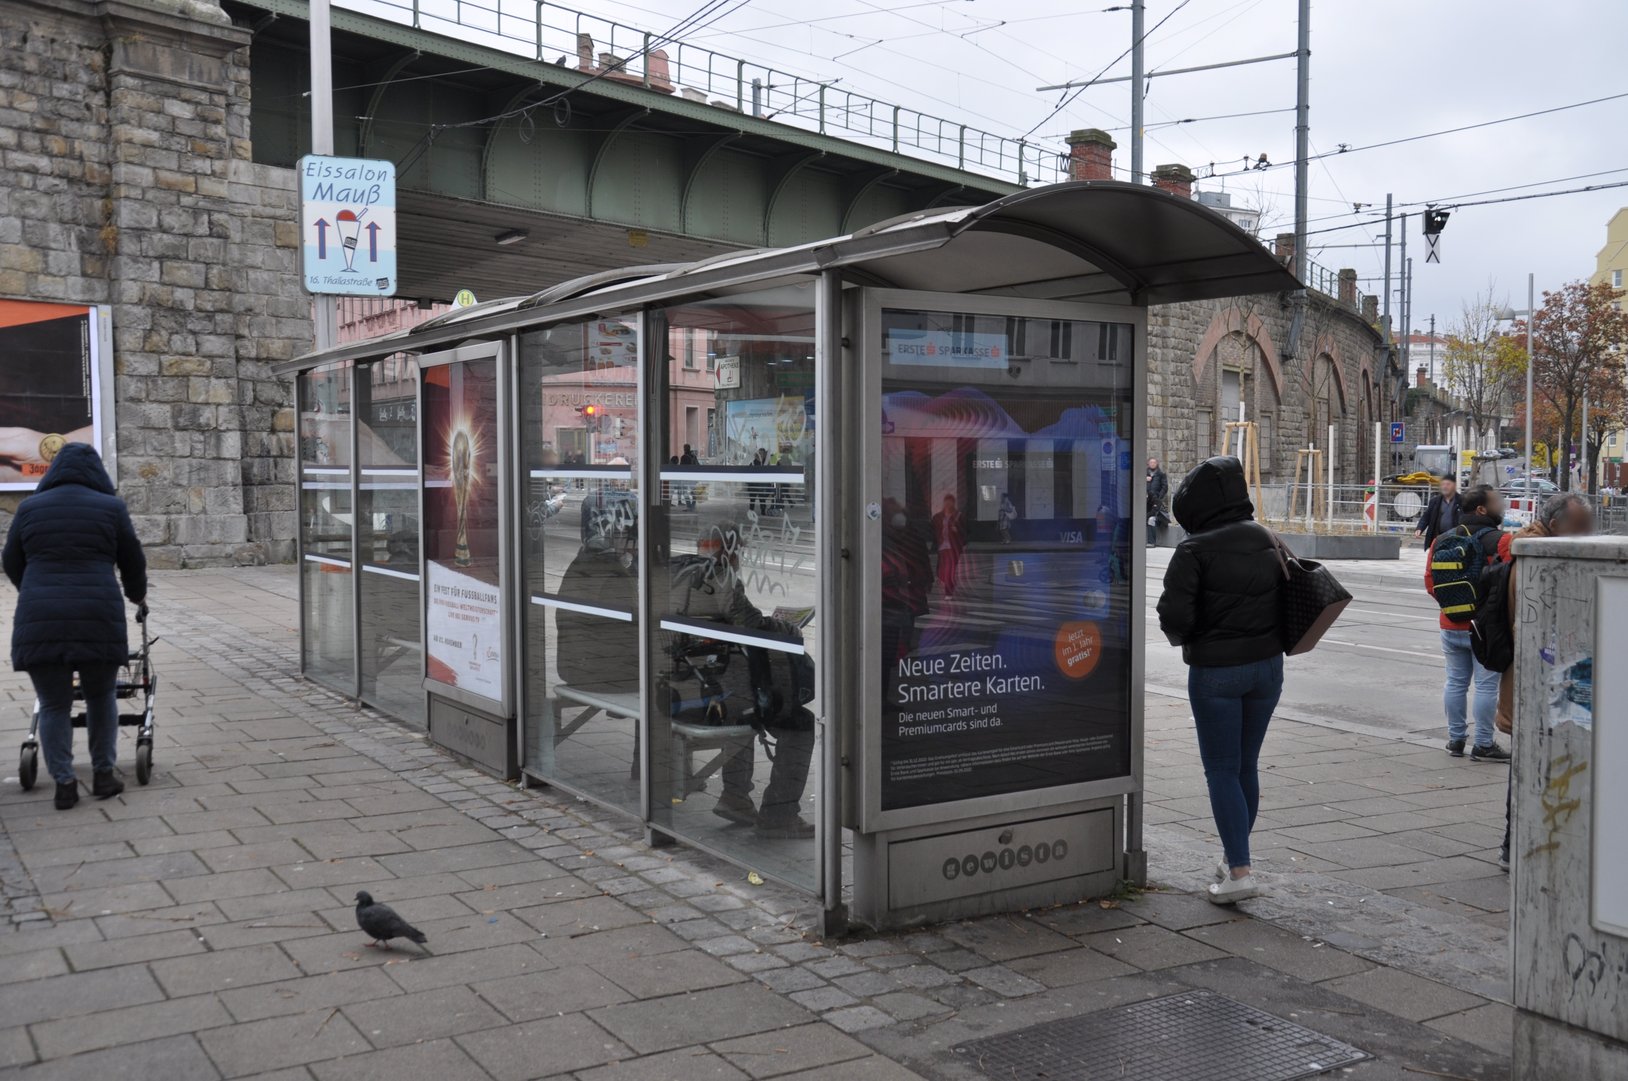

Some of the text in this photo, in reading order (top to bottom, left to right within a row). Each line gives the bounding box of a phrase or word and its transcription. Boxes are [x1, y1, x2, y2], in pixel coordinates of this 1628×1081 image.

[306, 161, 388, 181] Eissalon
[1060, 156, 1071, 171] W
[312, 182, 381, 206] Mauß
[323, 276, 373, 287] Thaliastraße
[461, 294, 470, 304] H
[898, 344, 990, 357] ERSTE SPARKASSE
[1060, 531, 1083, 544] VISA
[451, 586, 460, 598] FÜR
[461, 588, 497, 604] FUSSBALLFANS
[1067, 628, 1083, 642] Jetzt
[1062, 647, 1073, 656] im
[1079, 636, 1094, 649] Jahr
[899, 652, 1007, 677] Neue Zeiten.
[898, 674, 1045, 703] Smartere Karten.
[899, 703, 998, 723] Die neuen Smart- und
[899, 716, 1004, 736] Premiumcards sind da.
[944, 840, 1067, 879] gewista
